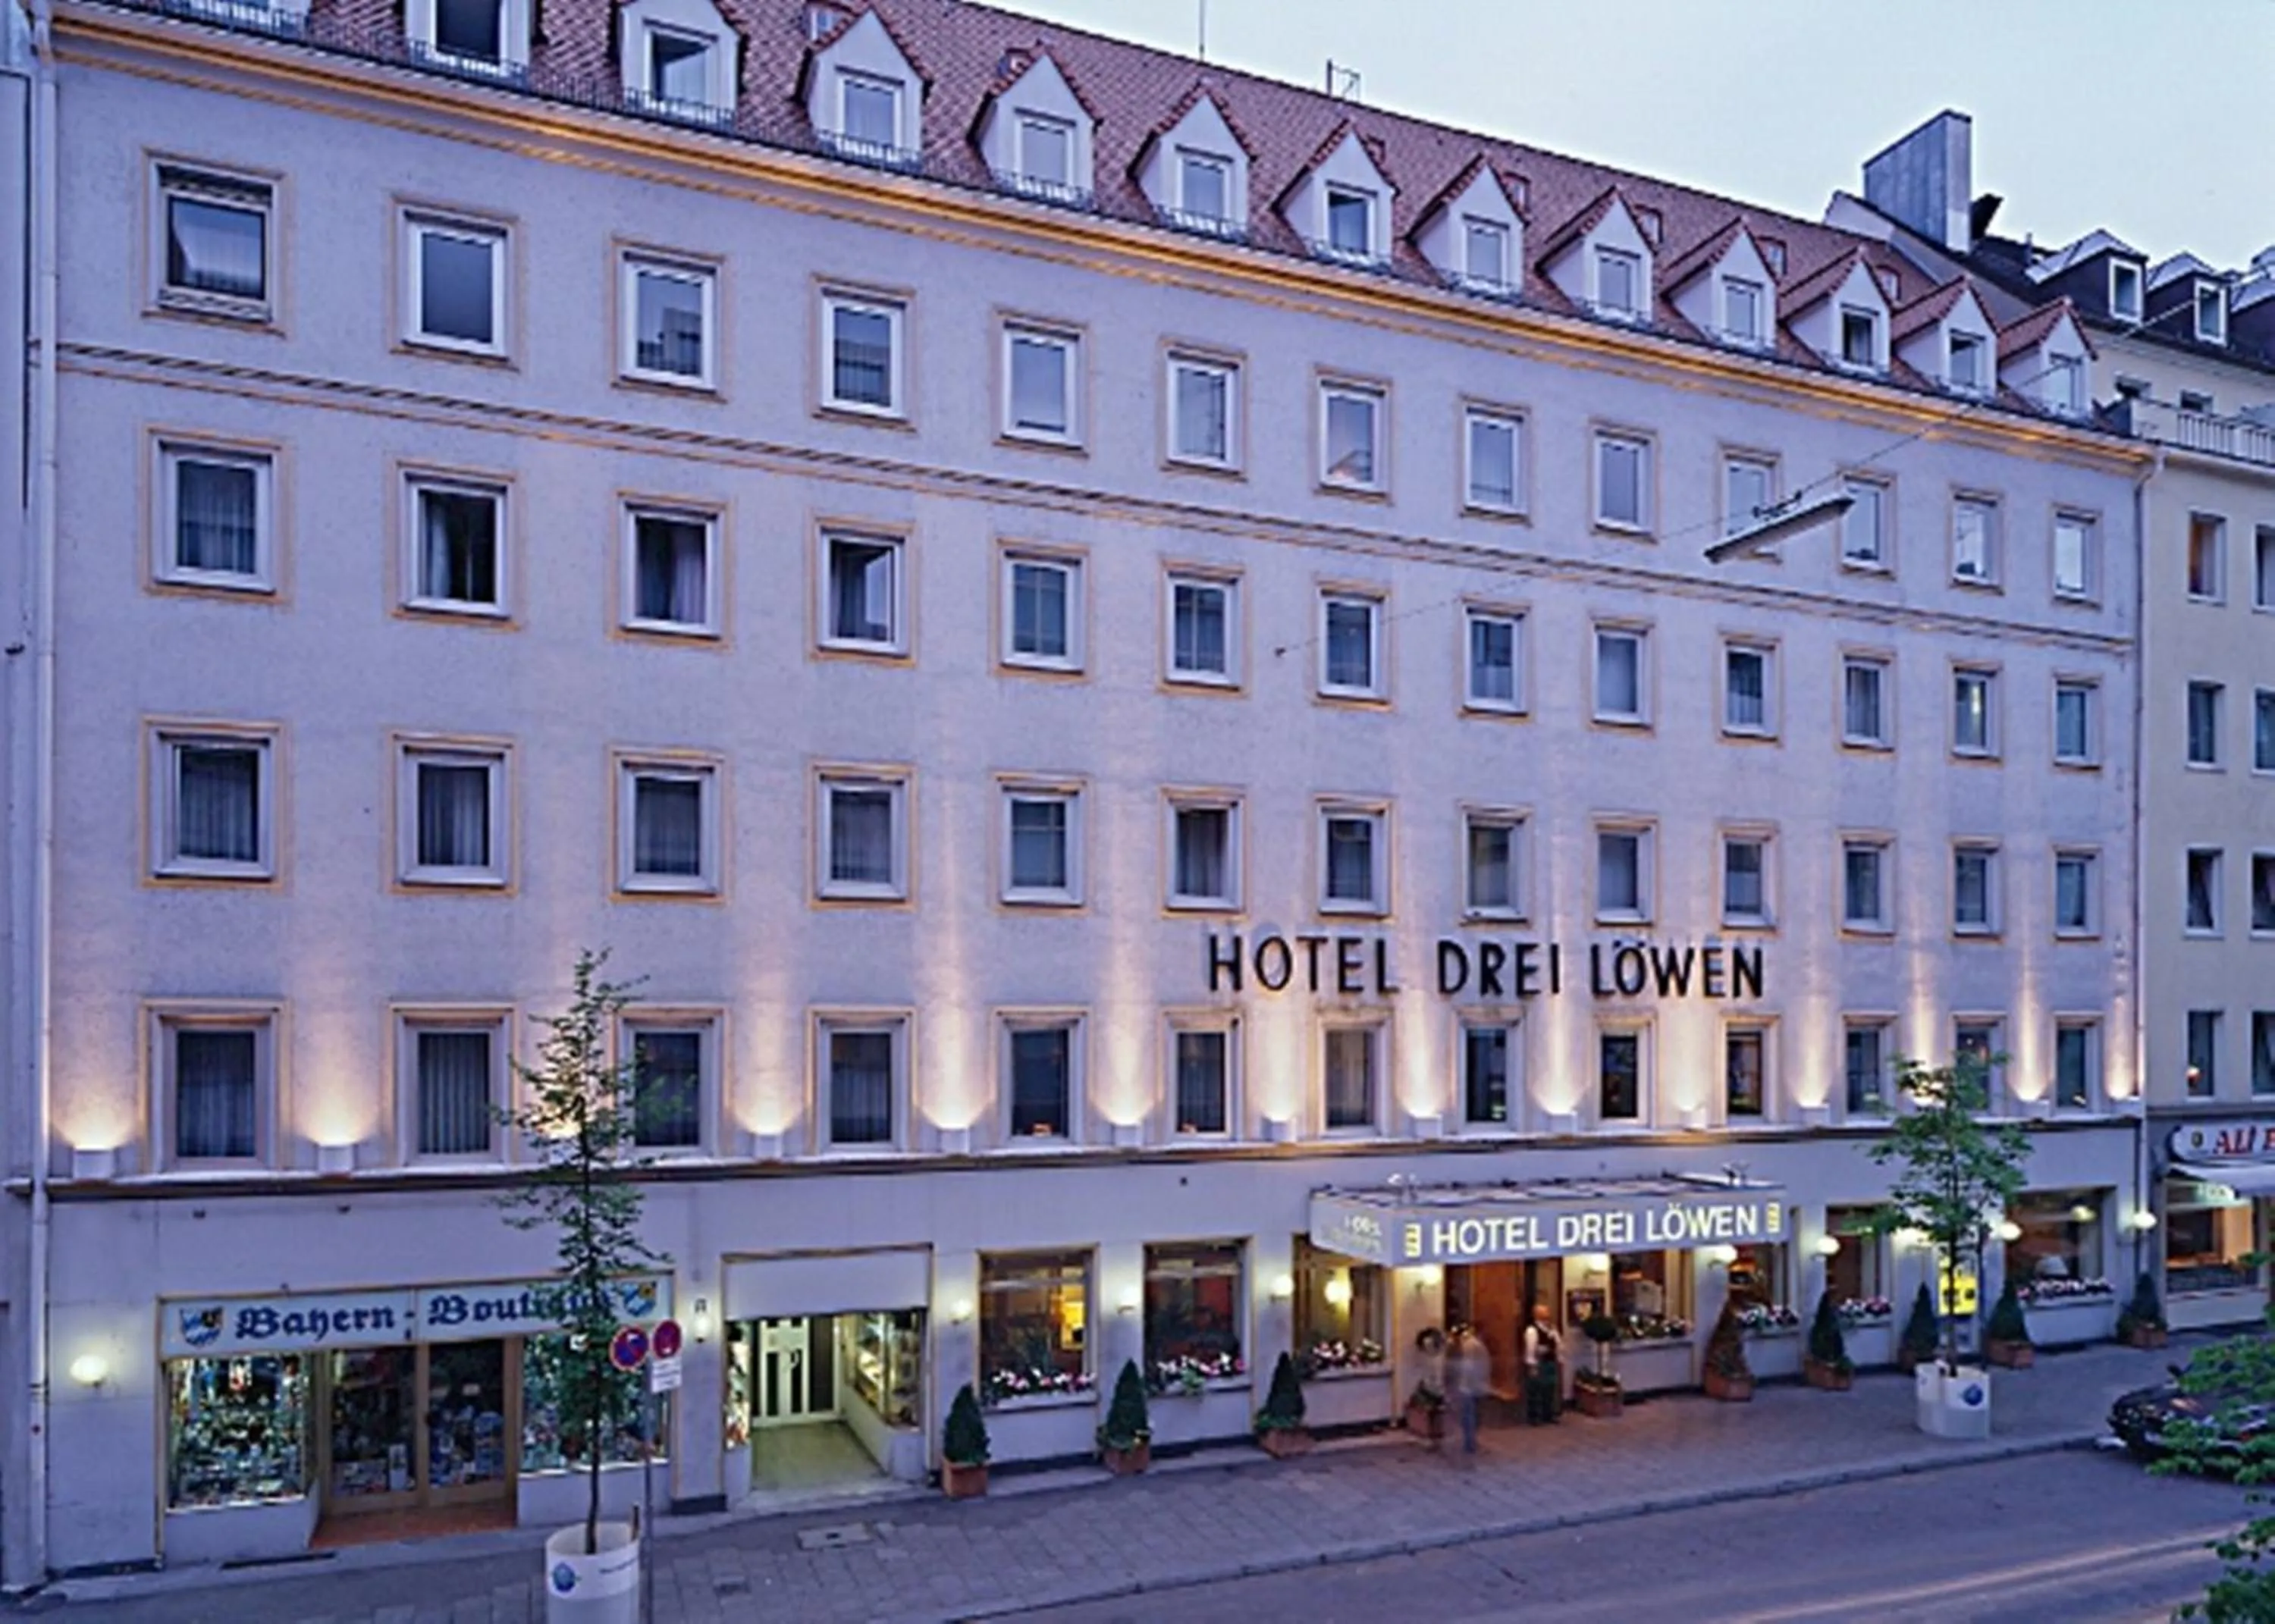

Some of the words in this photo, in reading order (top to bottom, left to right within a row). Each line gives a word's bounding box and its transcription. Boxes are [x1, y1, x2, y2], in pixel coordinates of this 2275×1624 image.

[1209, 934, 1400, 994] HOTEL
[1438, 939, 1560, 997] DREI
[1591, 940, 1763, 998] LÖWEN
[1432, 1215, 1549, 1256] HOTEL
[1558, 1212, 1635, 1247] DREI
[1646, 1204, 1757, 1242] LÖWEN
